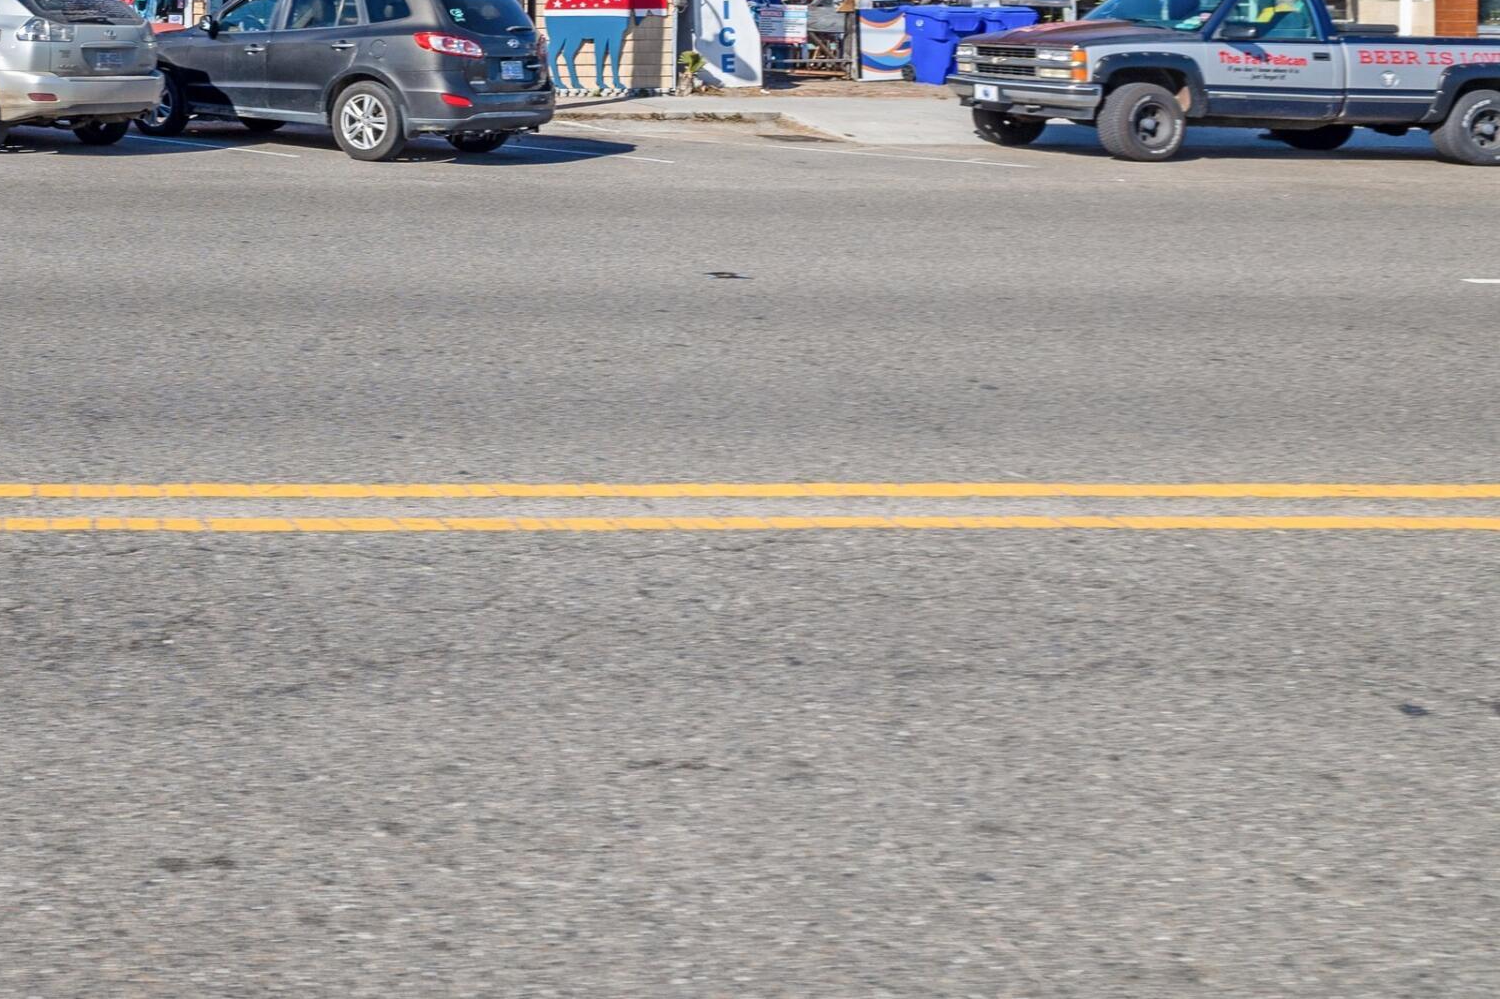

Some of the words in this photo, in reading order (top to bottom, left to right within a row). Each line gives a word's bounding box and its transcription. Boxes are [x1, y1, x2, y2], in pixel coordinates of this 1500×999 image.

[719, 0, 736, 73] ICE
[1218, 51, 1241, 64] The
[1358, 50, 1421, 65] BEER
[1425, 51, 1454, 65] IS
